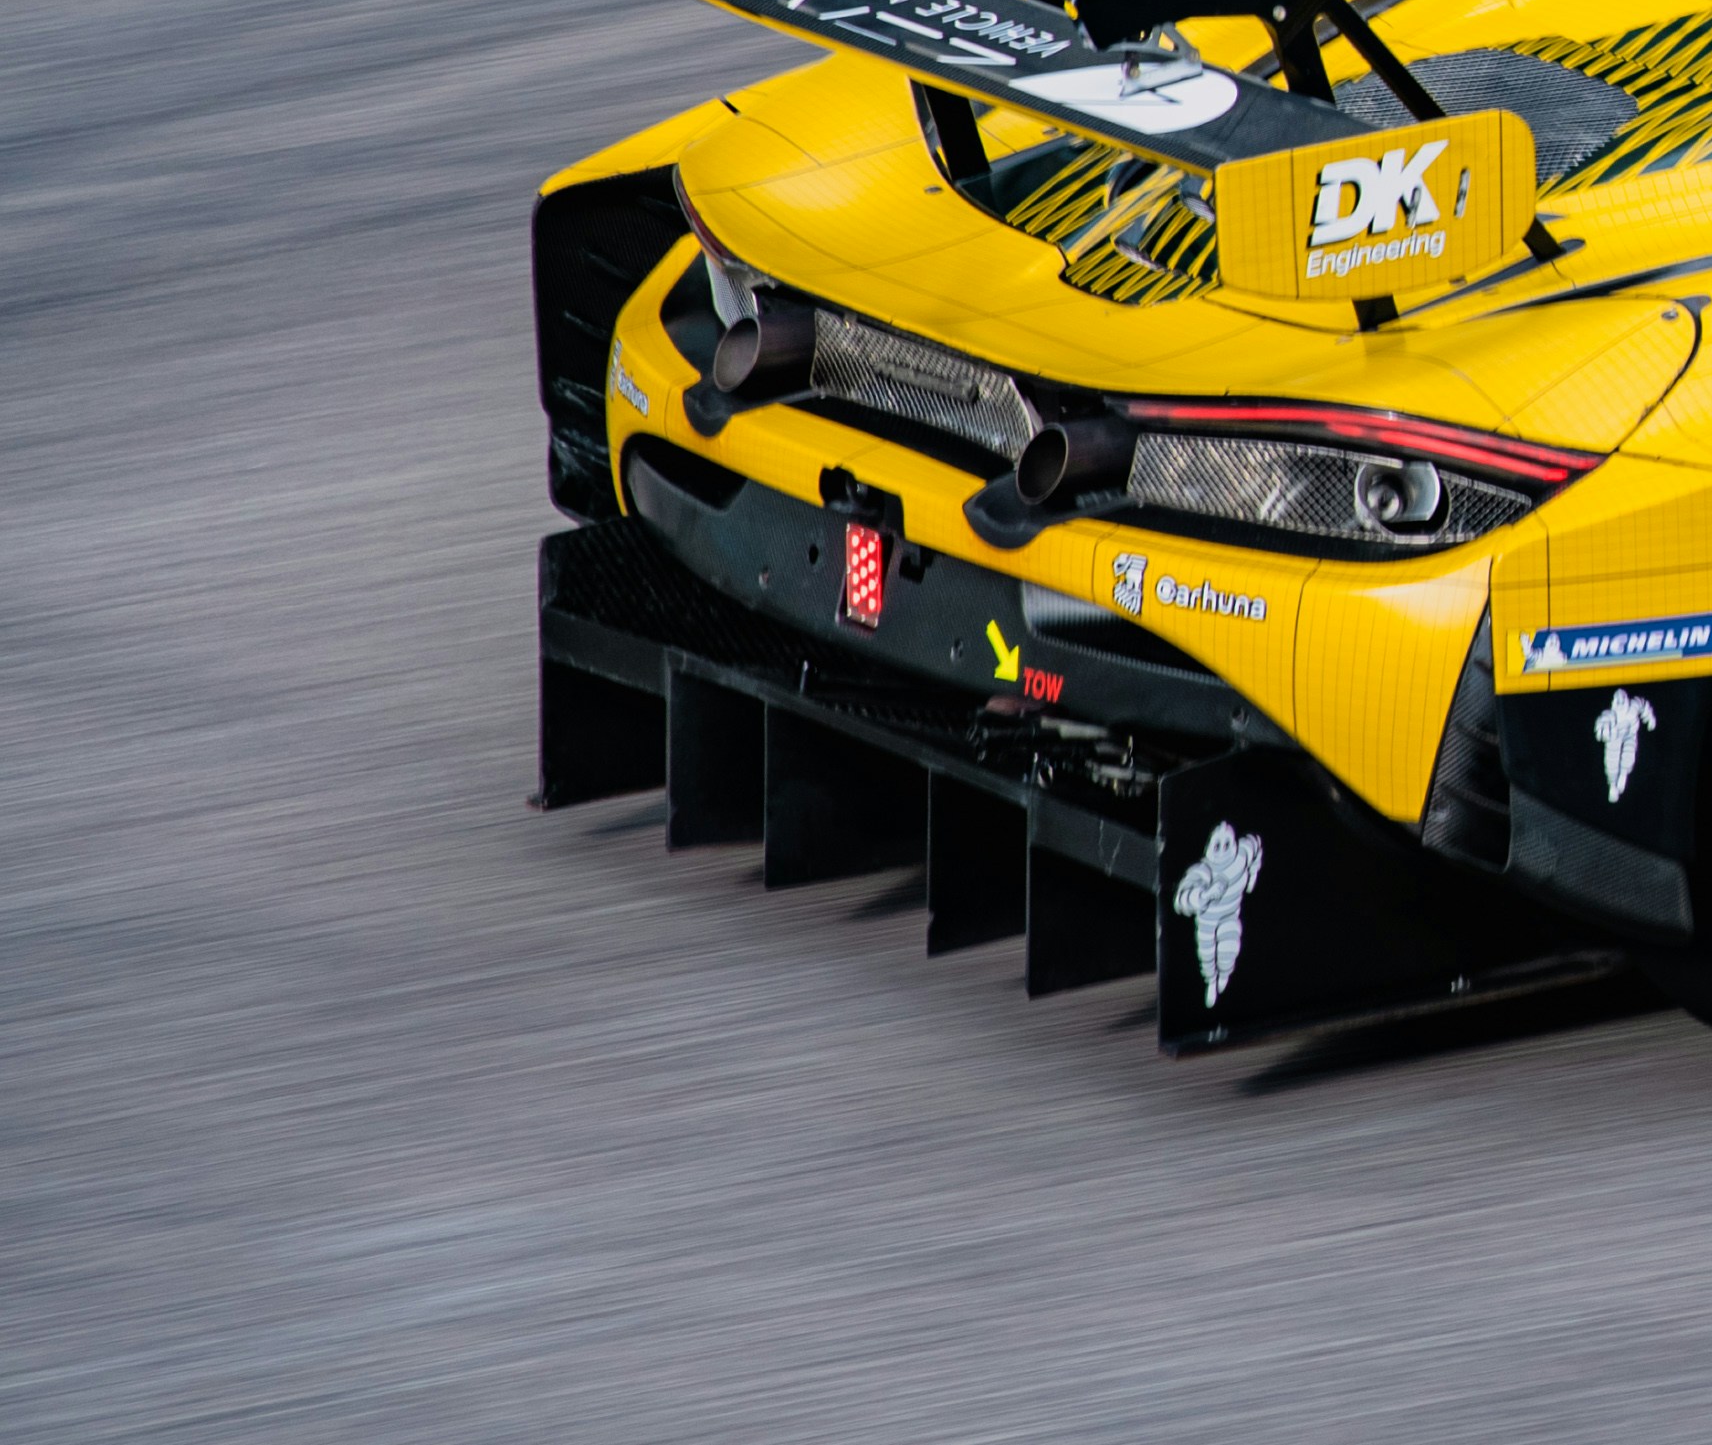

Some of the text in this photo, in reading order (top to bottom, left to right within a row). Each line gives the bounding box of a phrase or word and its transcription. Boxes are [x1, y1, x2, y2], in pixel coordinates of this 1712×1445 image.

[1306, 139, 1449, 248] DK
[1305, 228, 1447, 280] Engineering
[1156, 574, 1267, 621] Carhuna
[1571, 624, 1711, 659] MICHELIN
[1023, 666, 1065, 704] TOW
